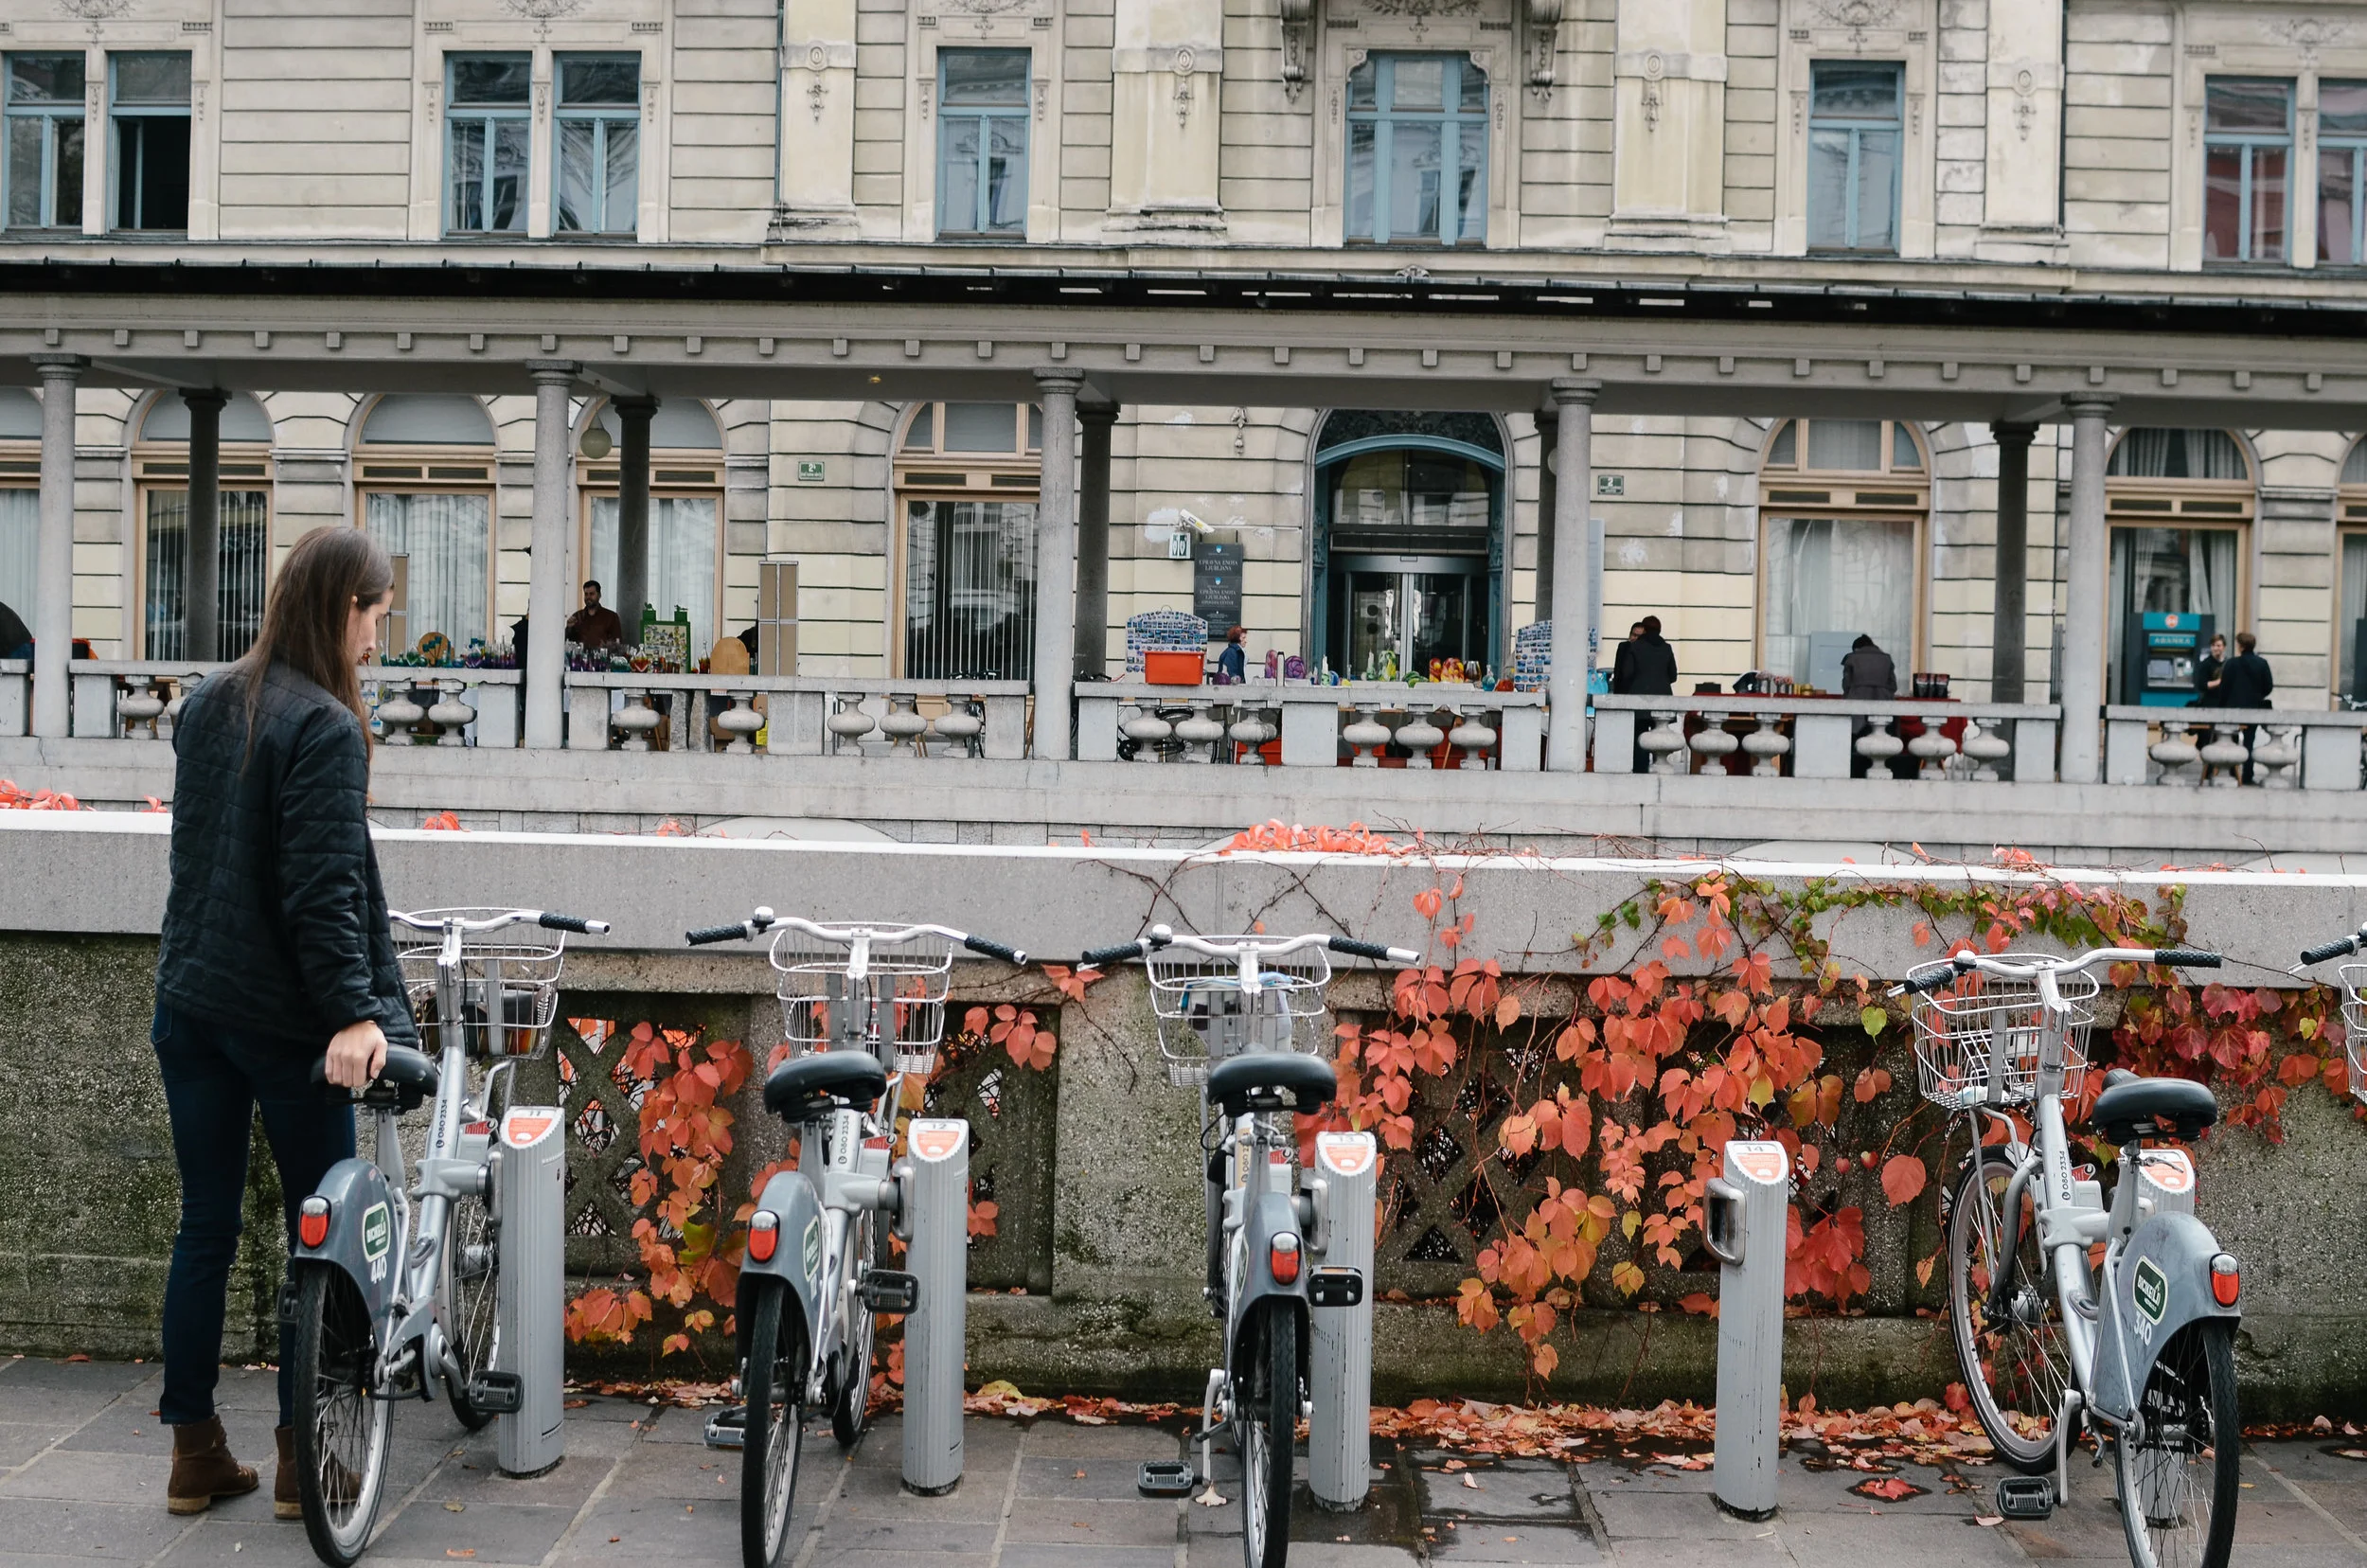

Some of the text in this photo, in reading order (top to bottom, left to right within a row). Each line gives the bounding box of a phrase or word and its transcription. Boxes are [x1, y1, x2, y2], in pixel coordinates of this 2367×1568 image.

[1607, 477, 1614, 487] 2
[2154, 636, 2191, 645] ABANKA
[437, 1099, 448, 1138] 080 2334
[840, 1136, 848, 1154] 080
[370, 1255, 387, 1284] 440
[2133, 1310, 2152, 1346] 340
